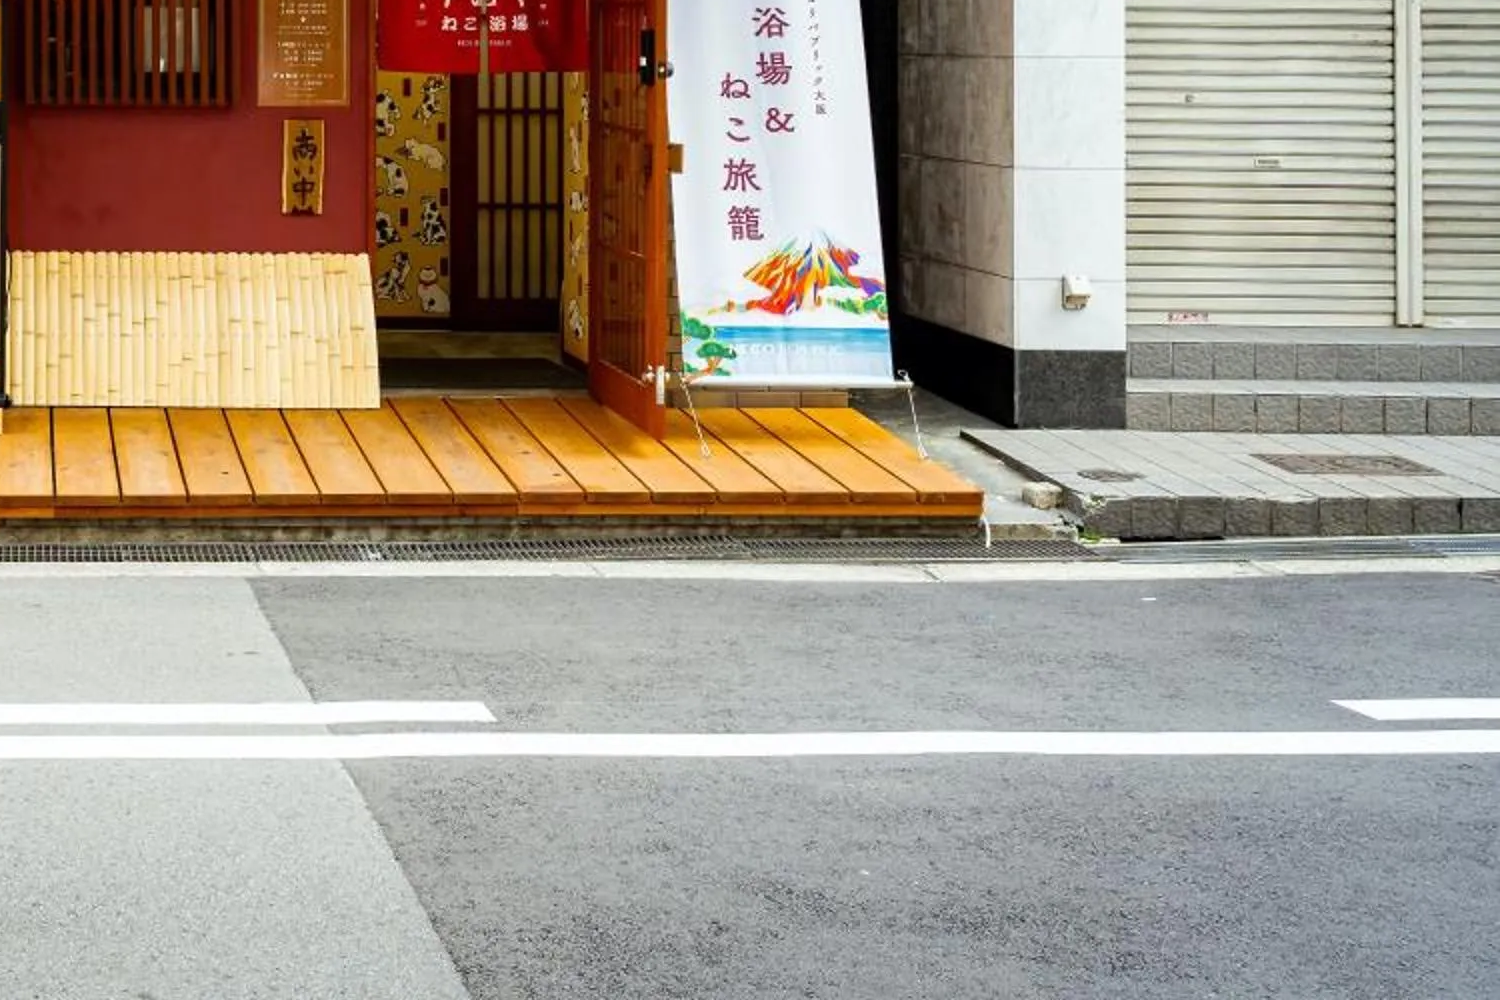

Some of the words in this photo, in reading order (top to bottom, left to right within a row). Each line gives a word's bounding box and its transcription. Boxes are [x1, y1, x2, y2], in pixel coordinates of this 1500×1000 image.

[441, 14, 529, 32] ねこ浴場
[719, 72, 764, 241] ねこ旅籠
